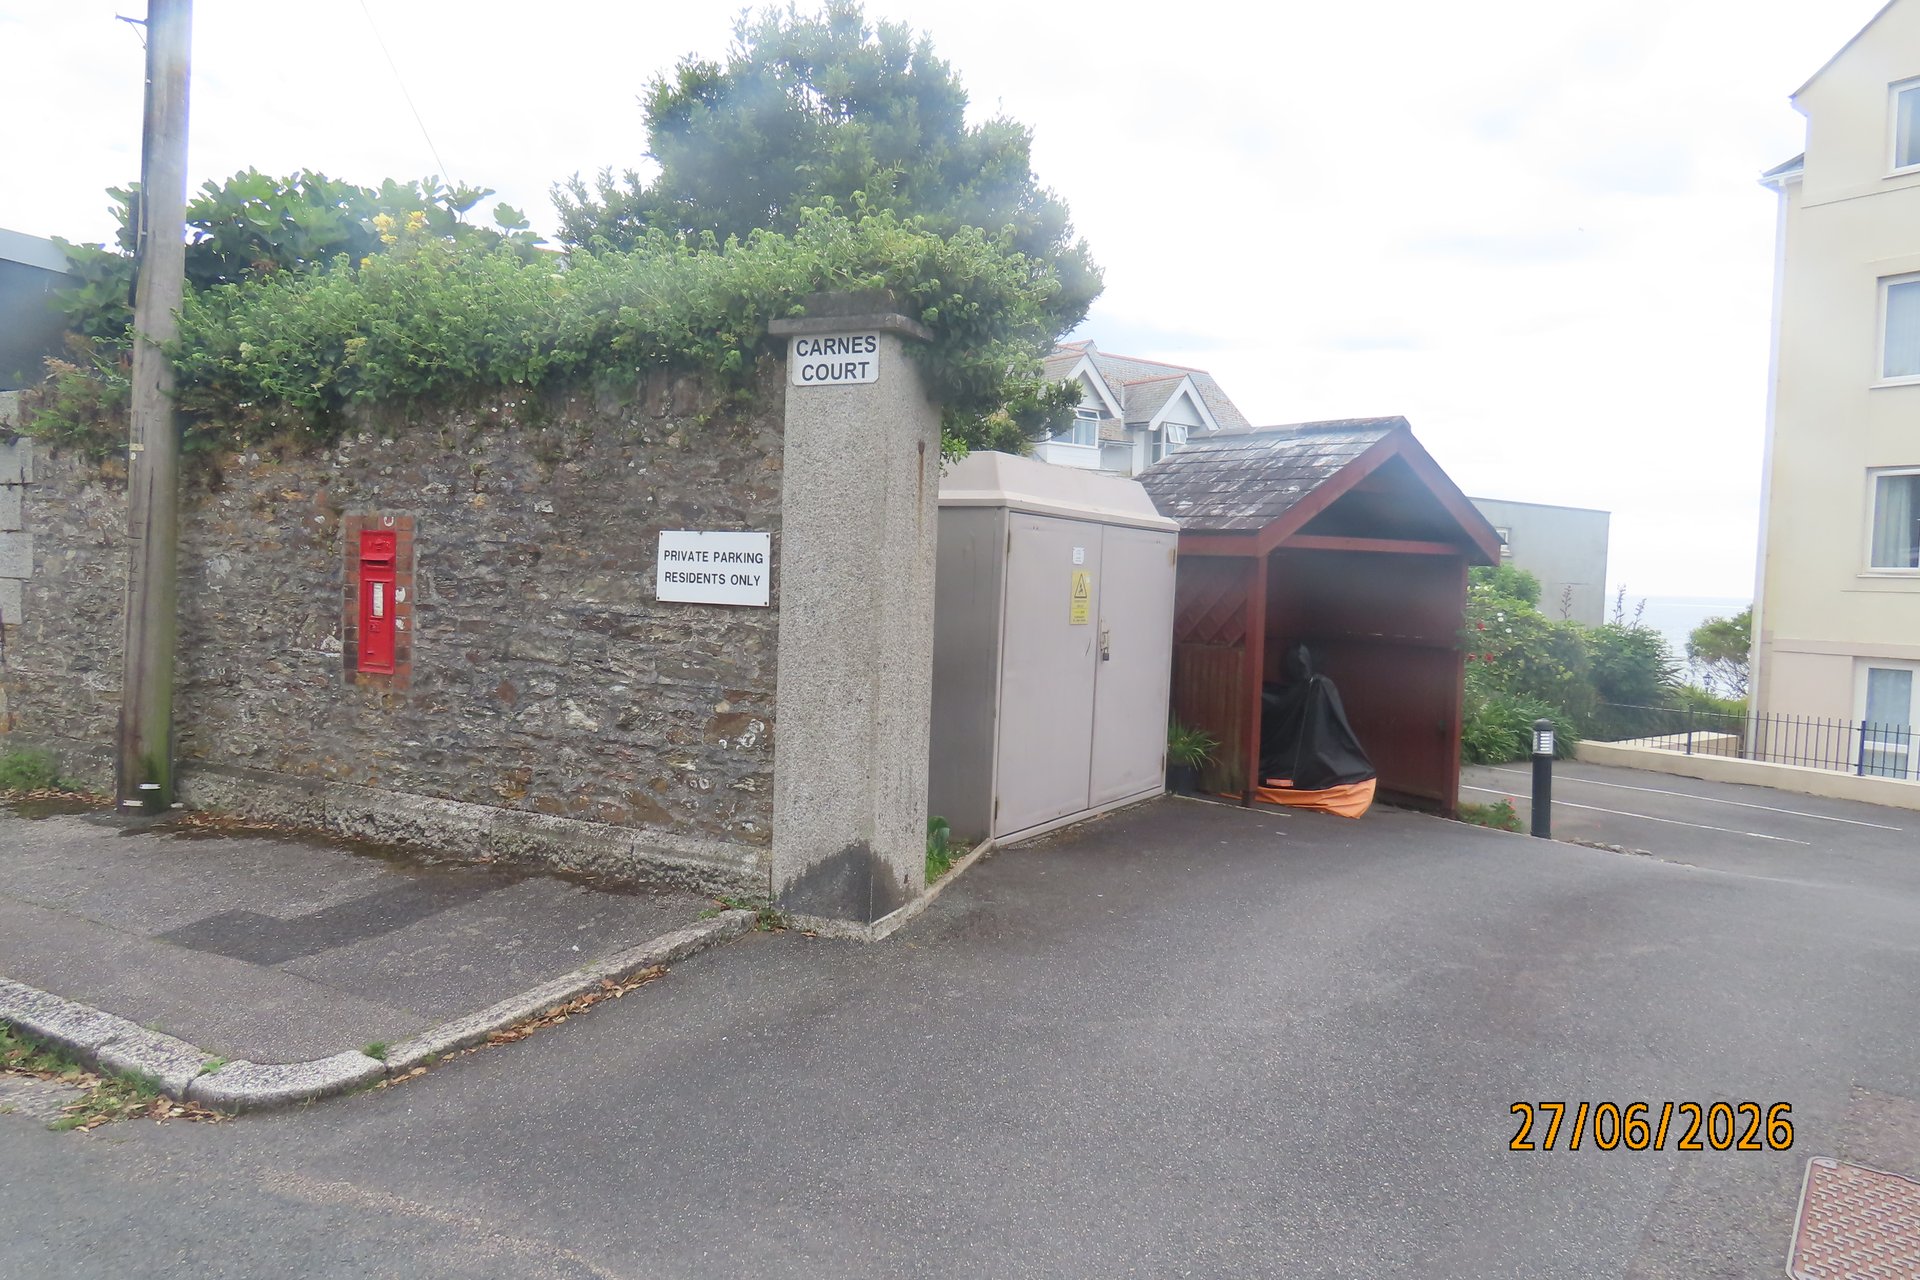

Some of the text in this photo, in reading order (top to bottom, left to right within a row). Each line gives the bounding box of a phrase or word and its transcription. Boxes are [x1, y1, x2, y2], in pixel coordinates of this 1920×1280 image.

[796, 335, 877, 357] CARNES
[801, 361, 870, 381] COURT
[663, 549, 764, 564] PRIVATE PARKING
[664, 571, 761, 586] RESIDENTS ONLY
